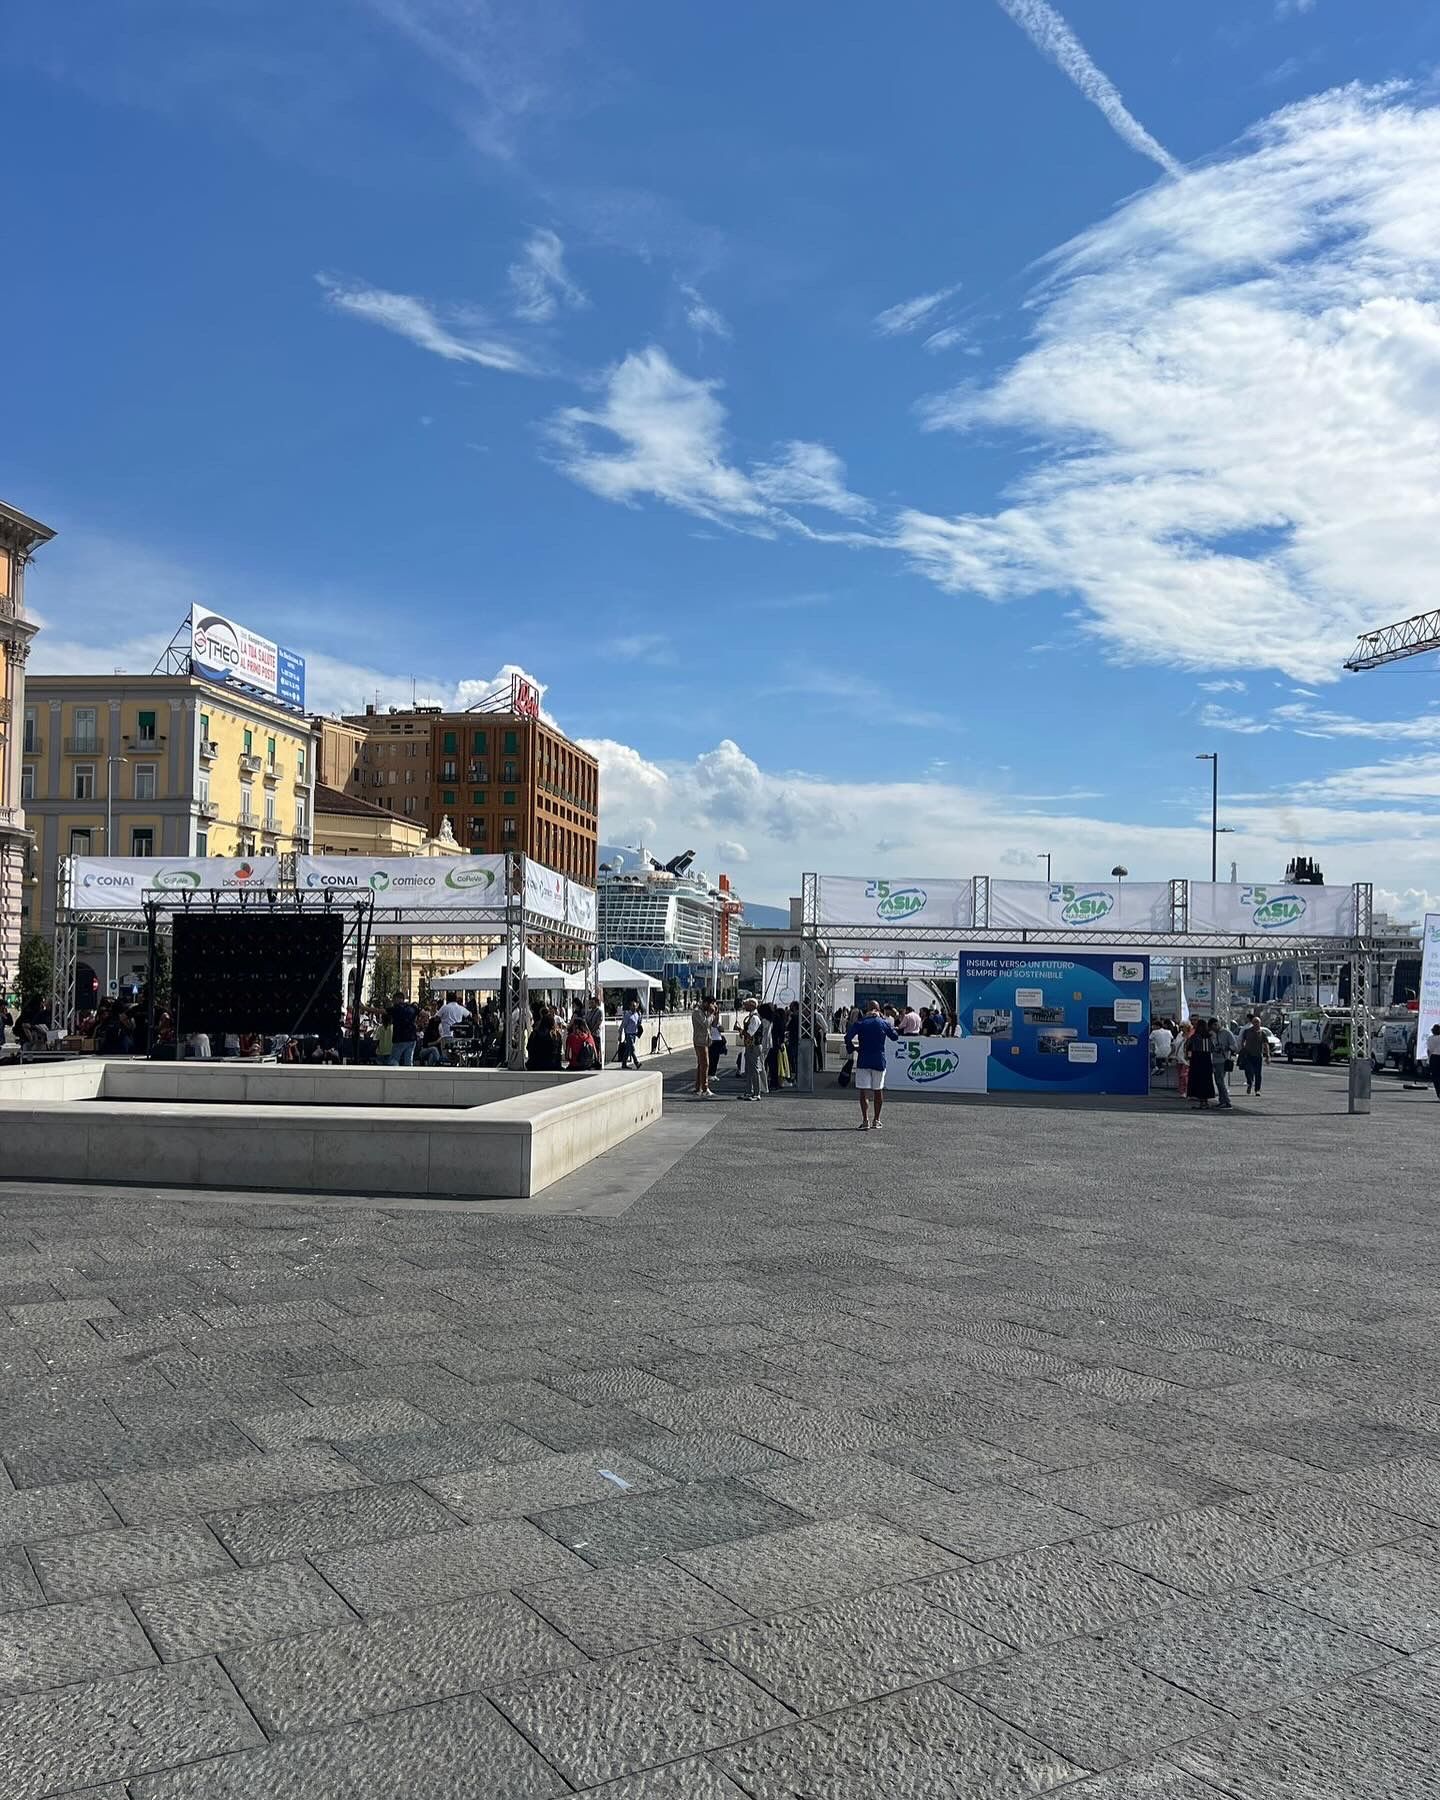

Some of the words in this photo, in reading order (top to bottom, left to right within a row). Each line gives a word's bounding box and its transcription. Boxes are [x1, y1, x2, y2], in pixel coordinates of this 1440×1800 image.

[207, 637, 239, 665] THEO
[97, 876, 134, 886] CONAI
[222, 878, 265, 888] biorepack
[321, 876, 358, 886] CONAI
[392, 874, 436, 886] comieco
[865, 880, 890, 898] 25
[1049, 885, 1075, 902] 25
[1241, 887, 1267, 905] 25
[881, 896, 921, 910] ASIA
[1066, 900, 1108, 914] ASIA
[1258, 903, 1301, 917] ASIA
[966, 959, 998, 968] INSIEME
[1000, 960, 1027, 968] VERSO
[1028, 961, 1041, 969] UN
[1041, 961, 1075, 969] FUTURO
[966, 969, 997, 977] SEMPRE
[999, 969, 1013, 978] PIÙ
[1014, 970, 1064, 979] SOSTENIBILE
[895, 1041, 921, 1059] 25
[911, 1058, 954, 1072] ASIA
